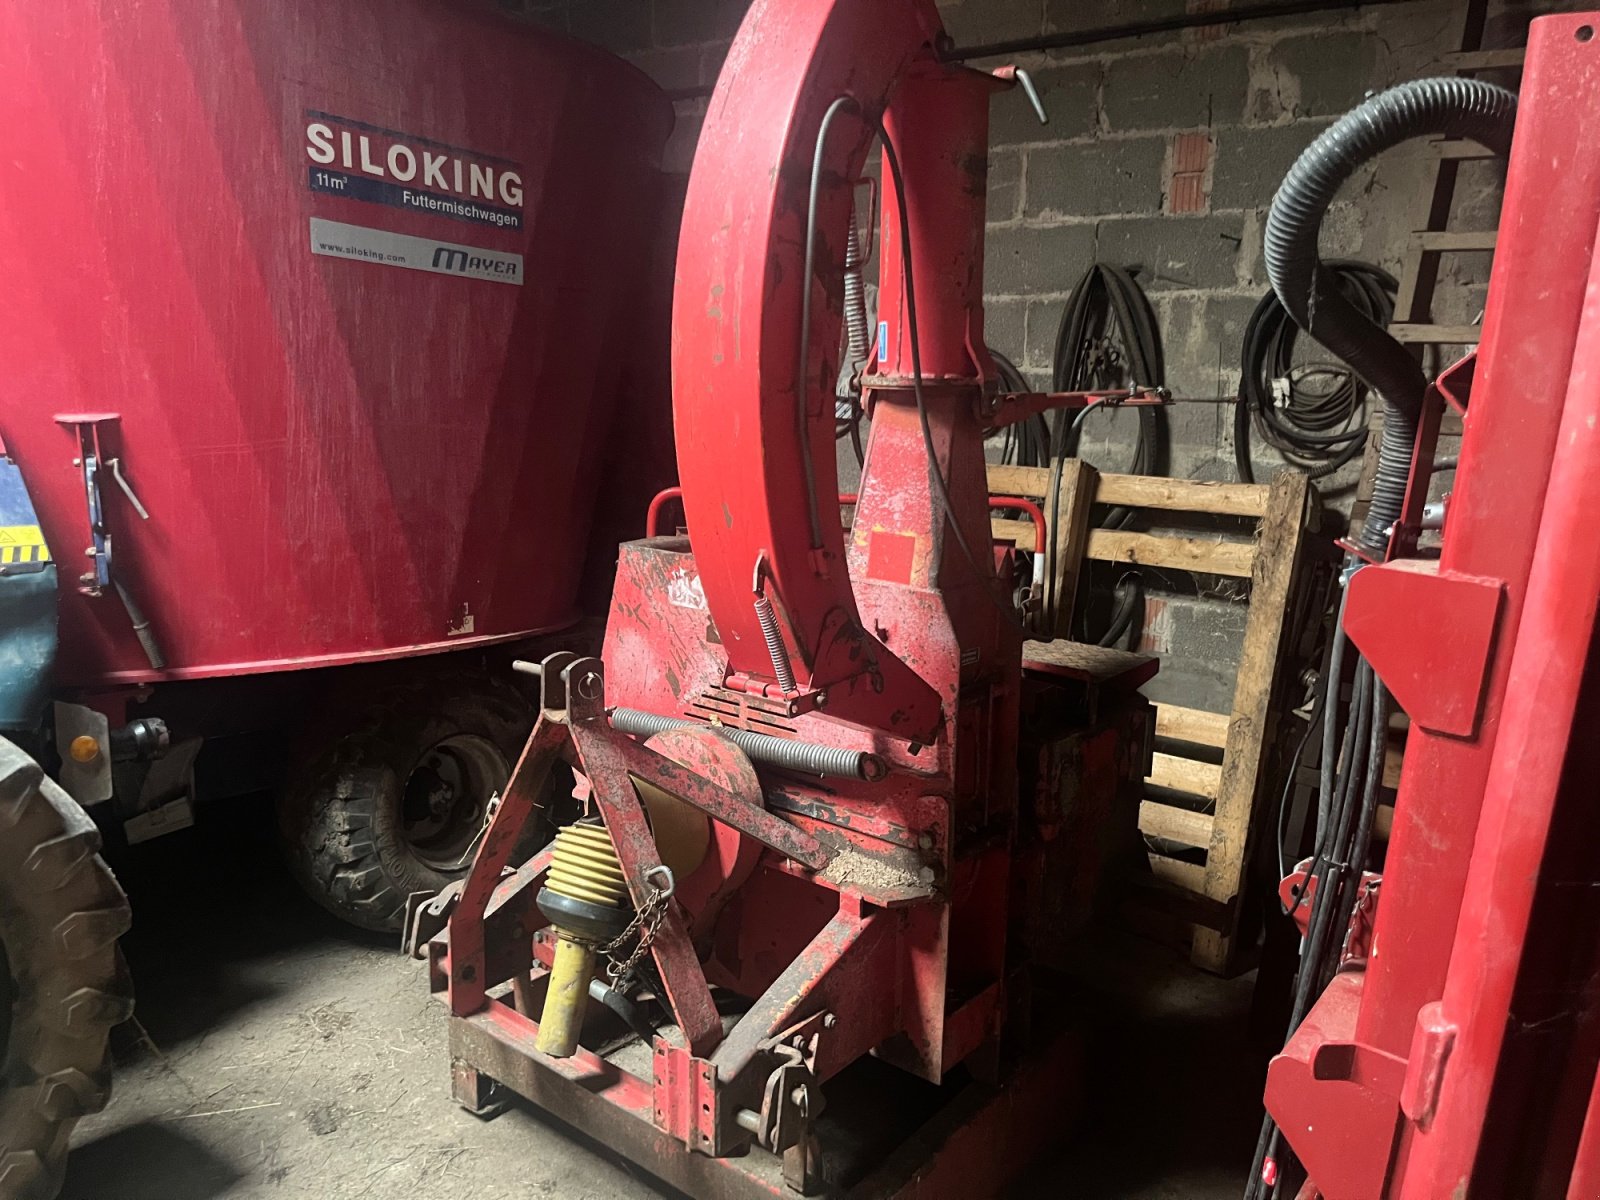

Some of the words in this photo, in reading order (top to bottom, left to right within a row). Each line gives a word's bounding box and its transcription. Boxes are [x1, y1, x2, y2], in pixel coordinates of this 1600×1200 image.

[306, 123, 523, 207] SILOKING
[403, 190, 518, 226] Futtermischwagen
[319, 242, 406, 263] www.siloking.com
[432, 247, 517, 275] MAYER
